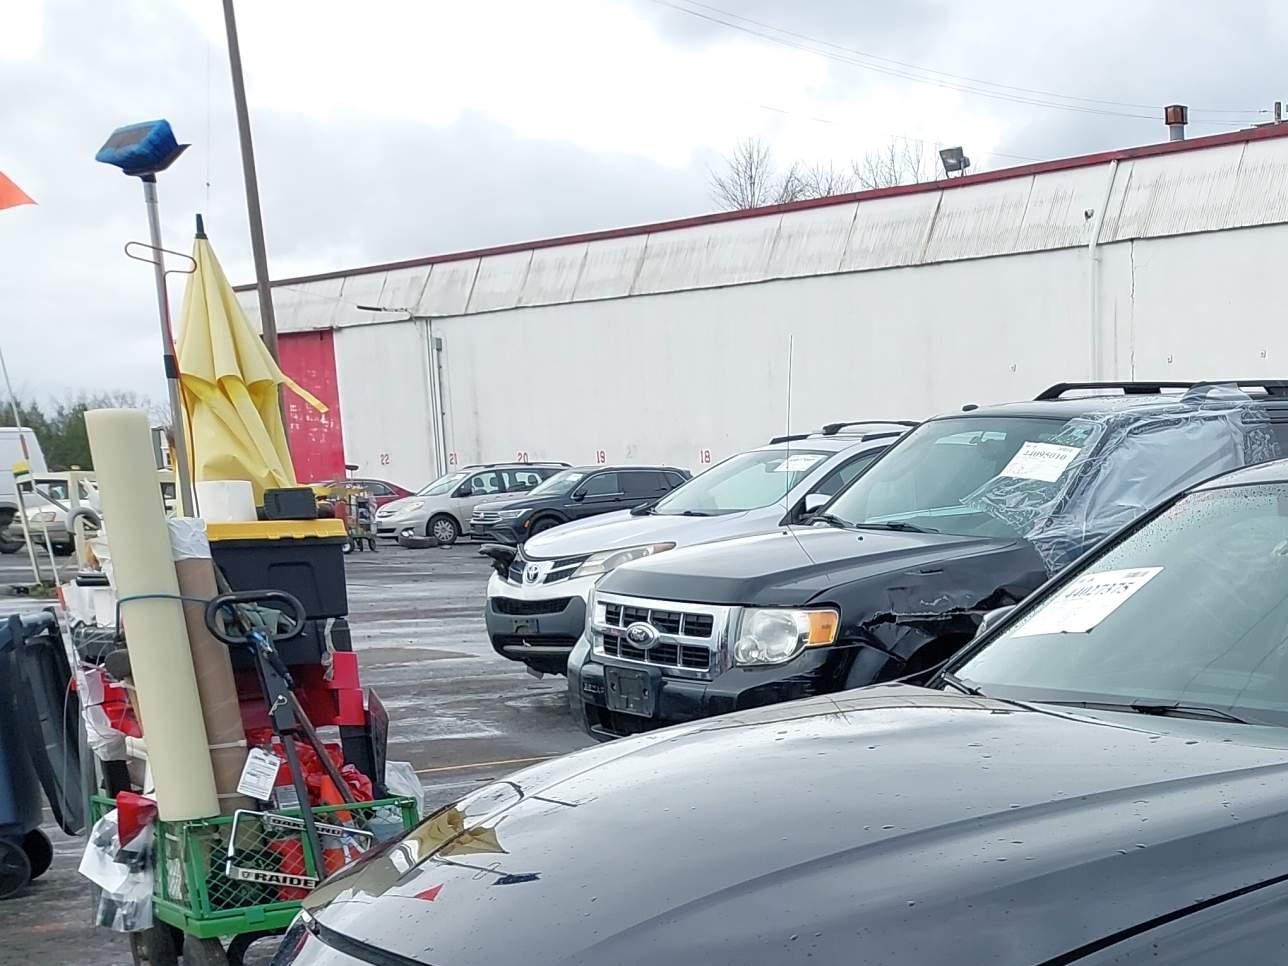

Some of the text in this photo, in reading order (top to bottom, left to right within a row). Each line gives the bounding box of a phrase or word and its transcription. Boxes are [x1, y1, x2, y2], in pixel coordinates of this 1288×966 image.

[380, 454, 390, 465] 22
[517, 452, 529, 463] 20
[596, 450, 606, 463] 19
[700, 450, 711, 463] 18
